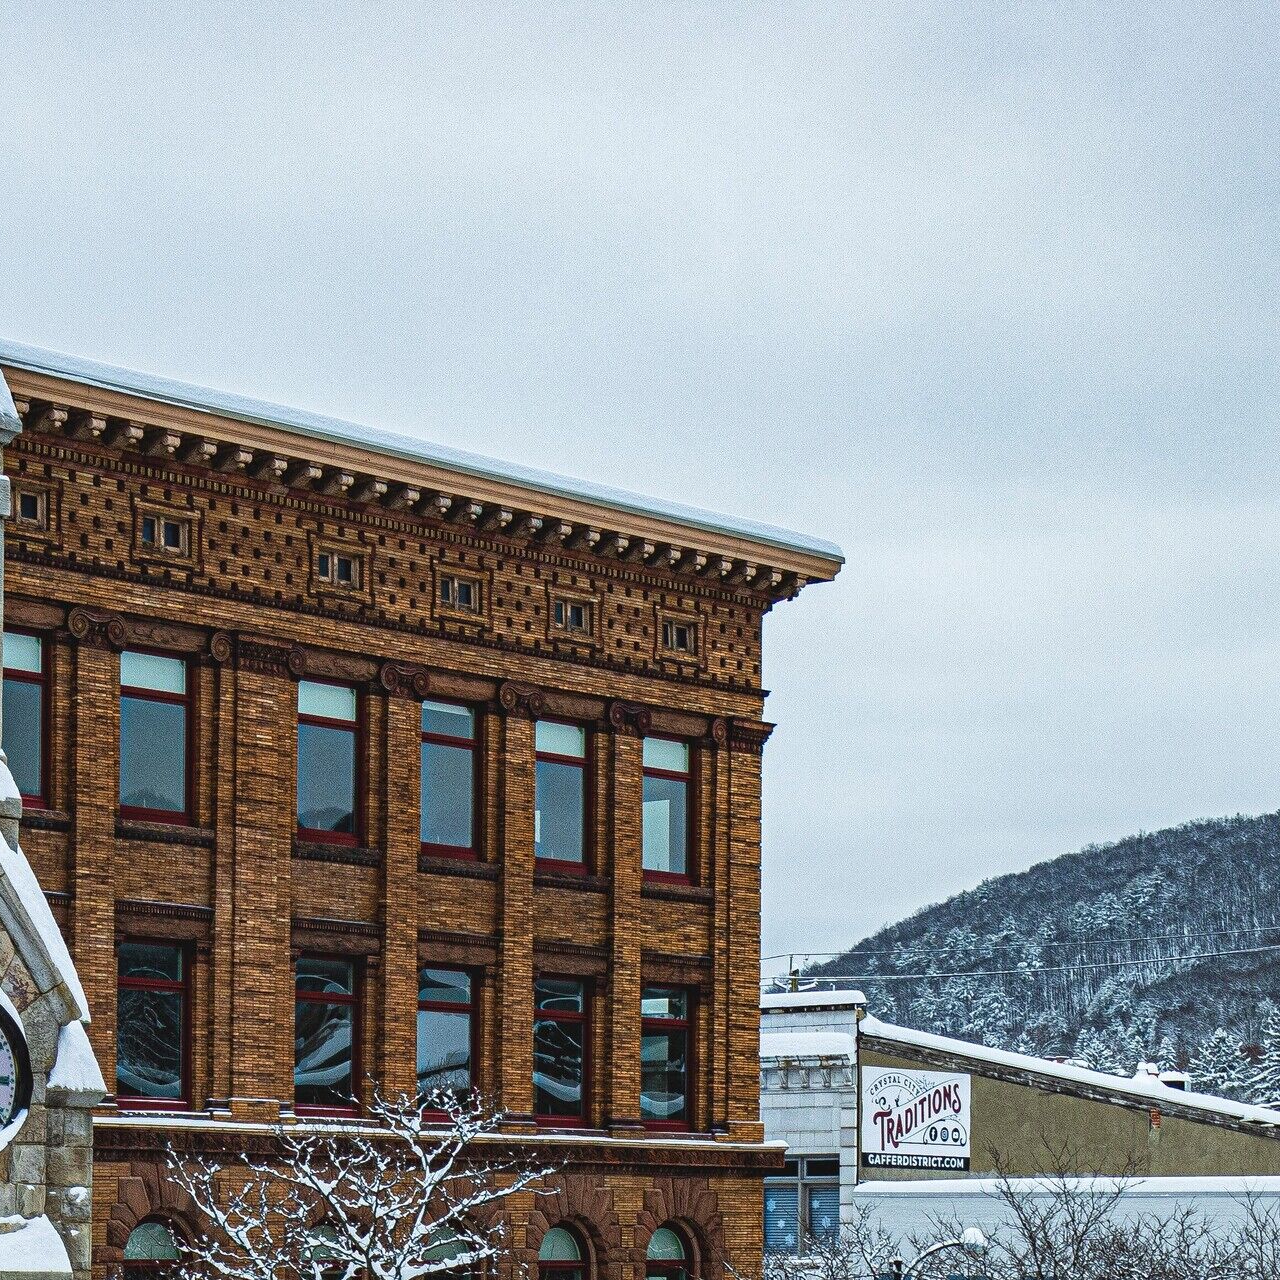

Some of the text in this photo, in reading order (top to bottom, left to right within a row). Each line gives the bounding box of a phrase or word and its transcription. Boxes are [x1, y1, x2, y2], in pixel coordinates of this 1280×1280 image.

[870, 1076, 920, 1096] CRYSTAL CITY
[873, 1083, 961, 1151] TRADITIONS
[868, 1153, 964, 1169] GAFFERDISTRICT.COM
